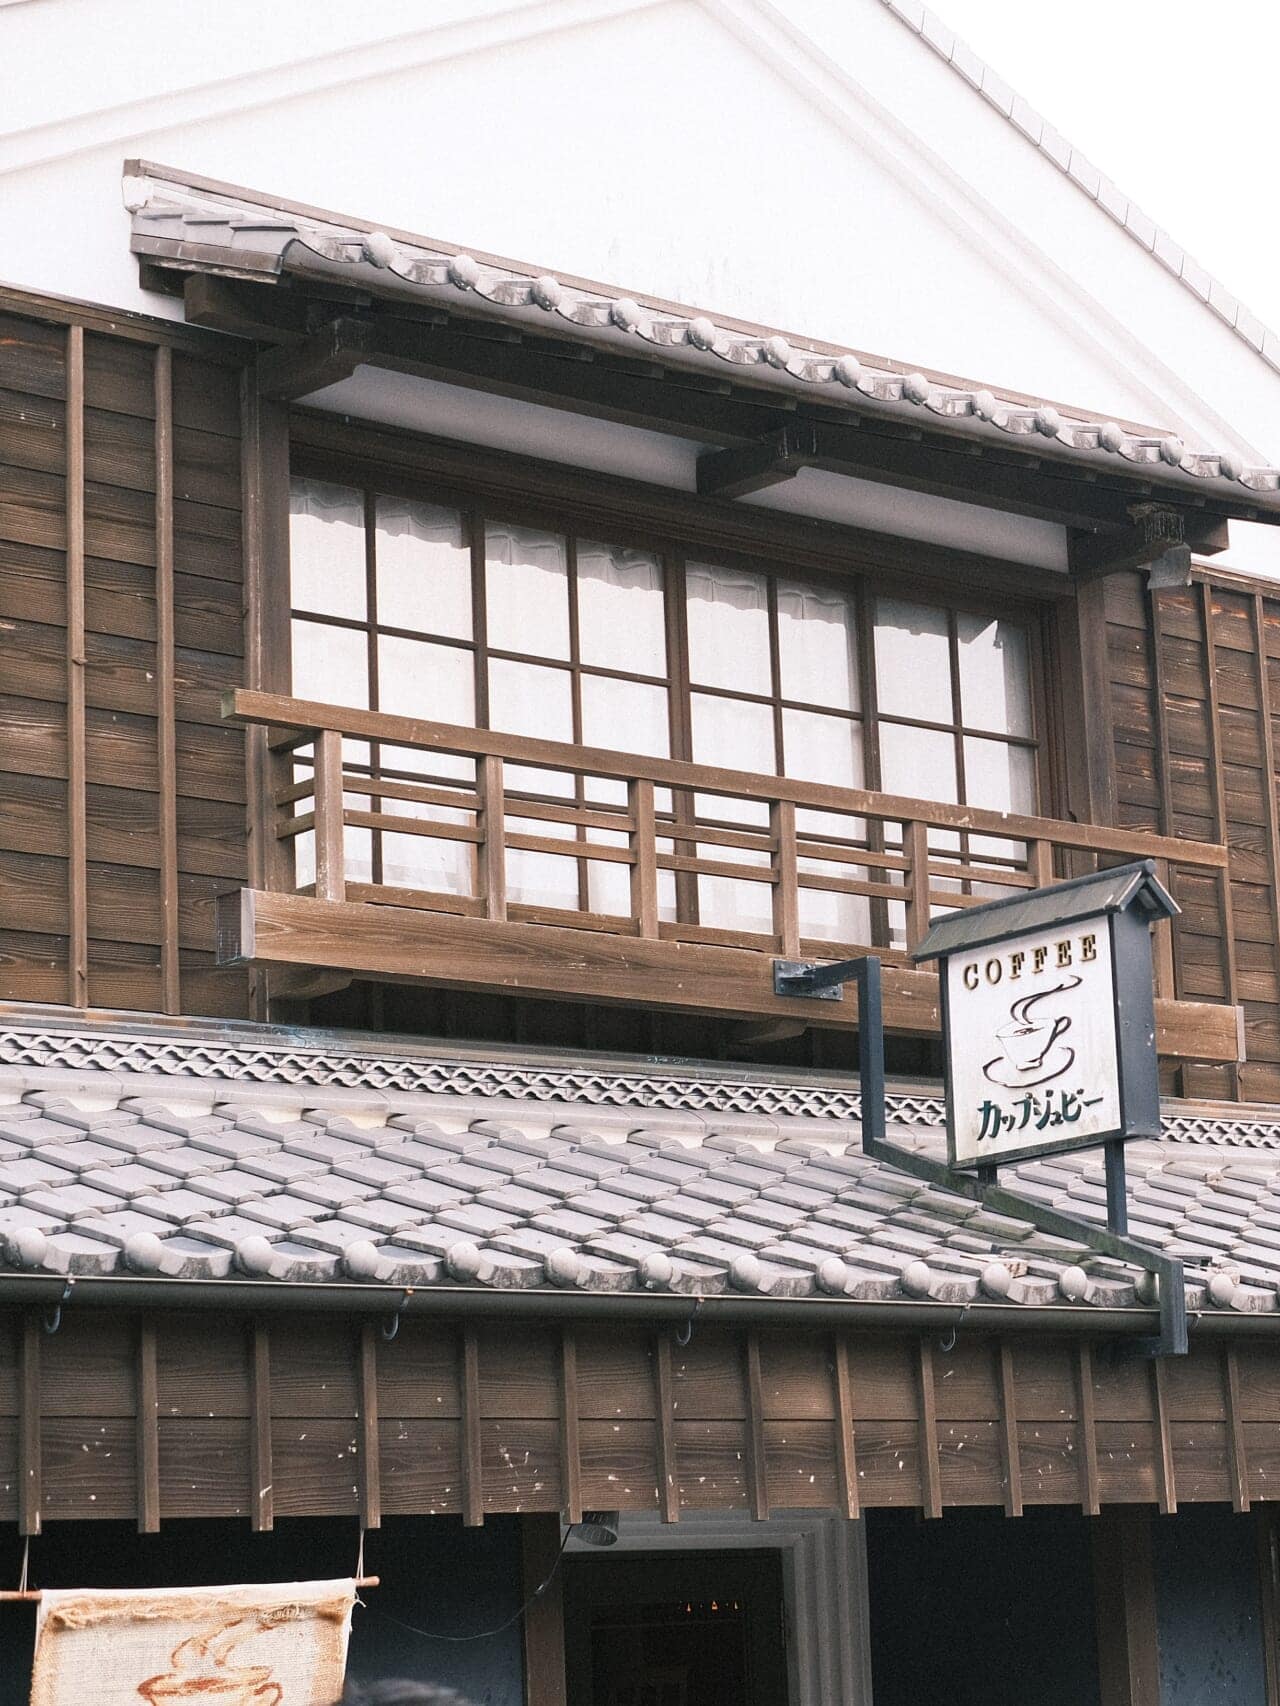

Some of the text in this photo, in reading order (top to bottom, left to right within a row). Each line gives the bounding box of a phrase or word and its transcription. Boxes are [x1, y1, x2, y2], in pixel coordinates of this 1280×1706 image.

[963, 934, 1097, 991] COFFEE
[977, 1088, 1104, 1141] カップジュビー
